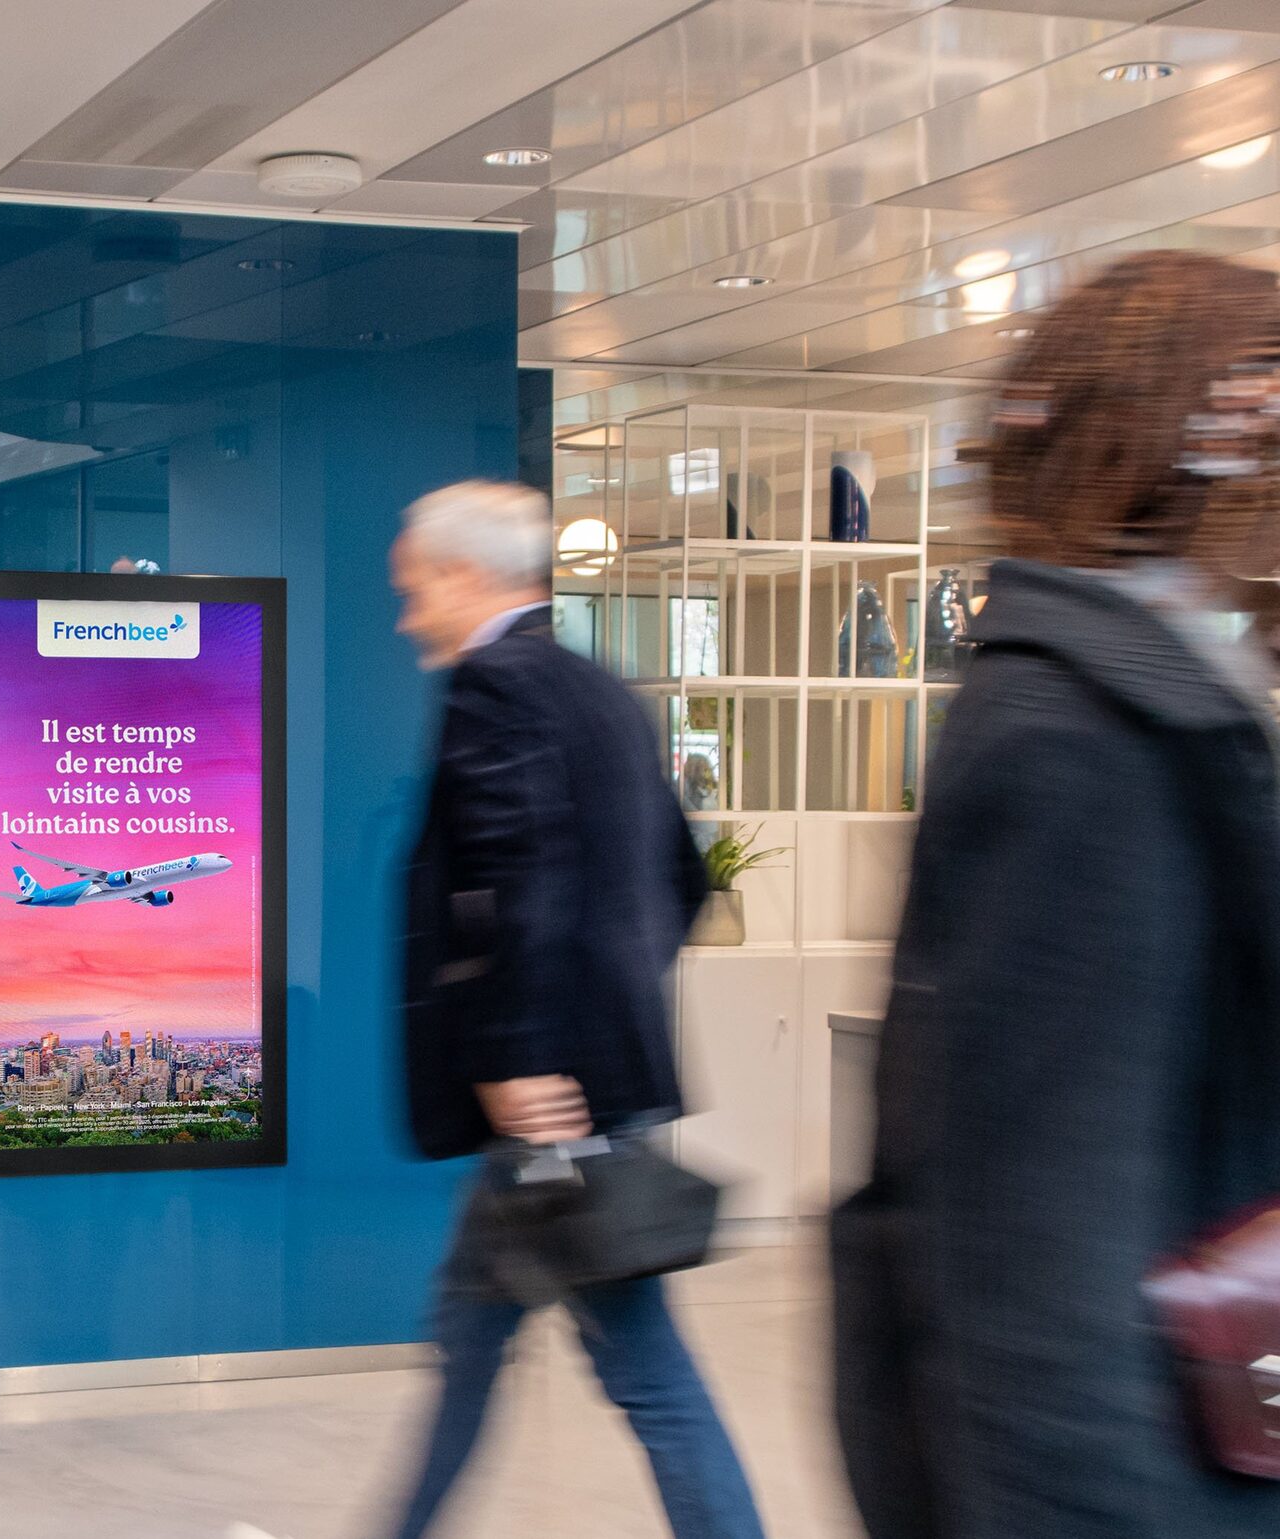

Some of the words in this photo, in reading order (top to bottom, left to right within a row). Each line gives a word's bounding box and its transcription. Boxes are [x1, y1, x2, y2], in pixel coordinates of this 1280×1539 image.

[53, 620, 168, 641] Frenchbee
[41, 719, 59, 743] Il
[65, 722, 106, 743] est
[112, 722, 196, 749] temps
[56, 750, 87, 774] de
[94, 751, 183, 774] rendre
[46, 781, 120, 804] visite
[125, 781, 141, 804] à
[146, 786, 191, 804] vos
[1, 811, 120, 834] lointains
[126, 811, 236, 834] cousins.
[17, 1104, 35, 1112] Paris
[74, 1102, 89, 1110] New
[90, 1101, 106, 1110] York
[110, 1100, 132, 1109] Miami
[136, 1101, 150, 1109] San
[151, 1100, 183, 1108] Francisco
[188, 1099, 201, 1107] Los
[201, 1099, 227, 1107] Angeles
